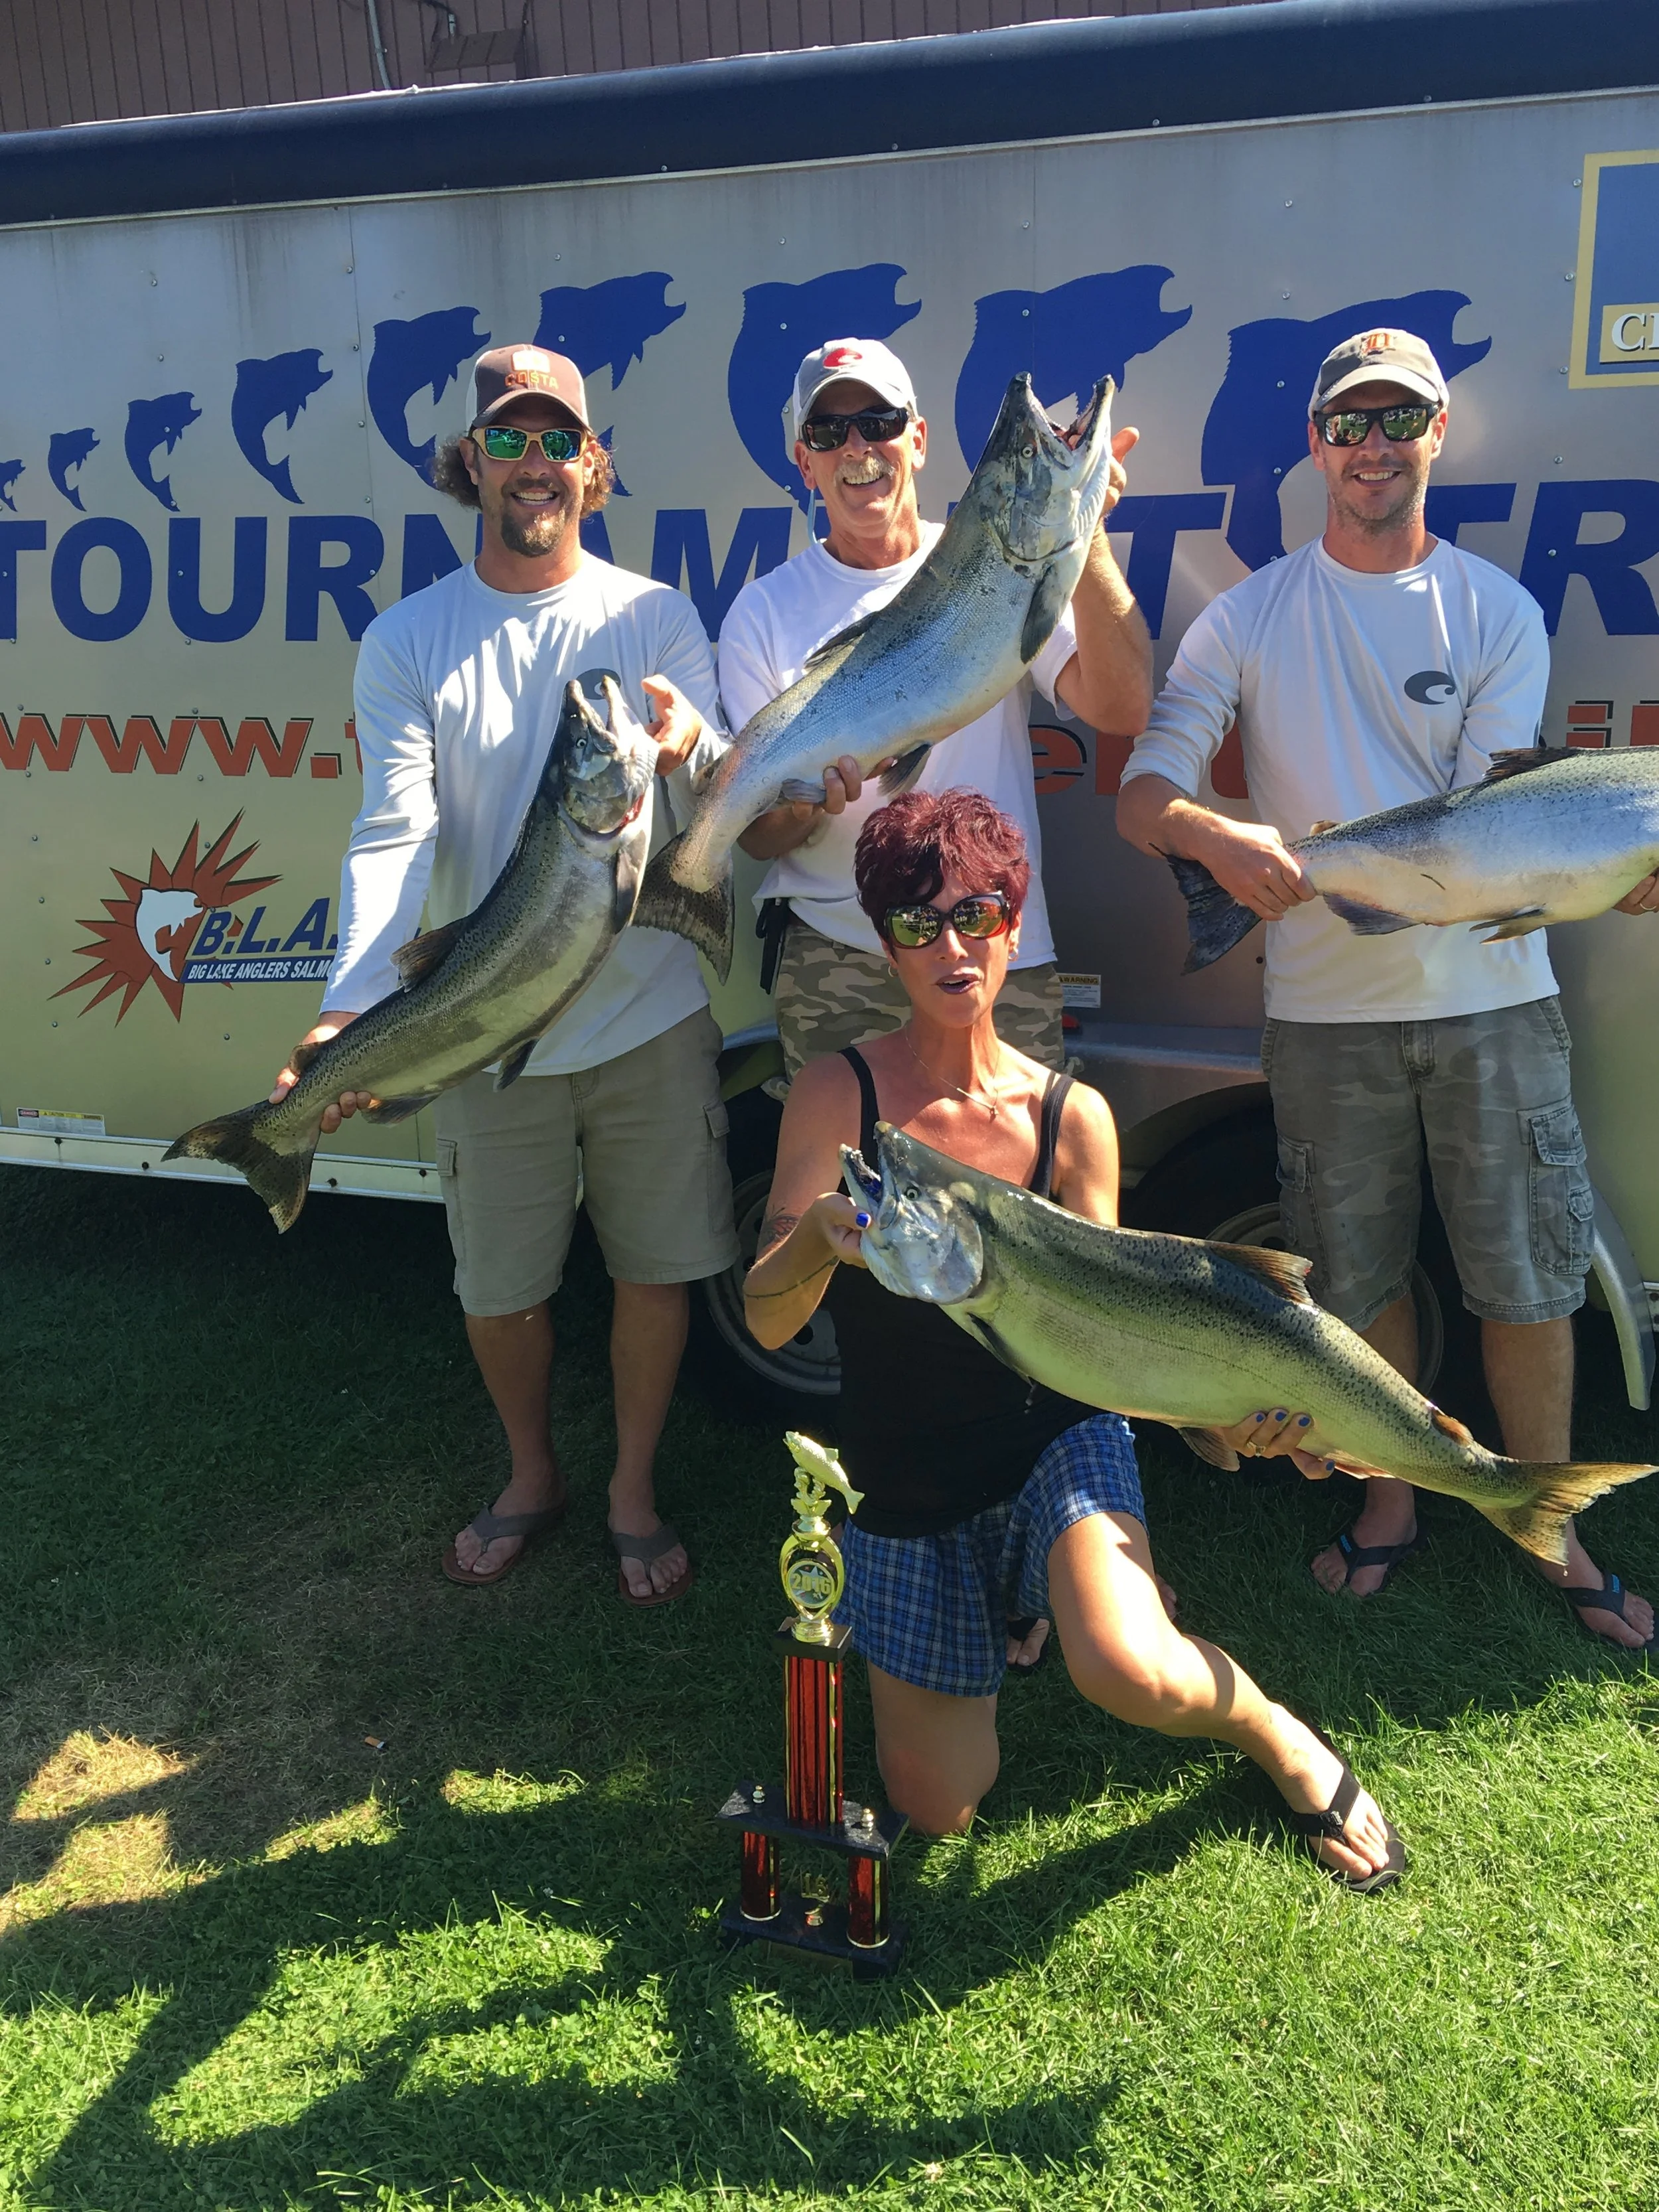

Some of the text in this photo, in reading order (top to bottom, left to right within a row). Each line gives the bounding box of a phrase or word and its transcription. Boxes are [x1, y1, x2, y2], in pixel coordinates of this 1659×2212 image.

[504, 372, 559, 390] COSTA
[0, 492, 1227, 642] TOURMT
[0, 711, 363, 779] www.
[188, 964, 206, 980] BIG
[206, 963, 234, 980] LAKE
[234, 961, 291, 979] ANGLERS
[792, 1573, 831, 1594] 2016
